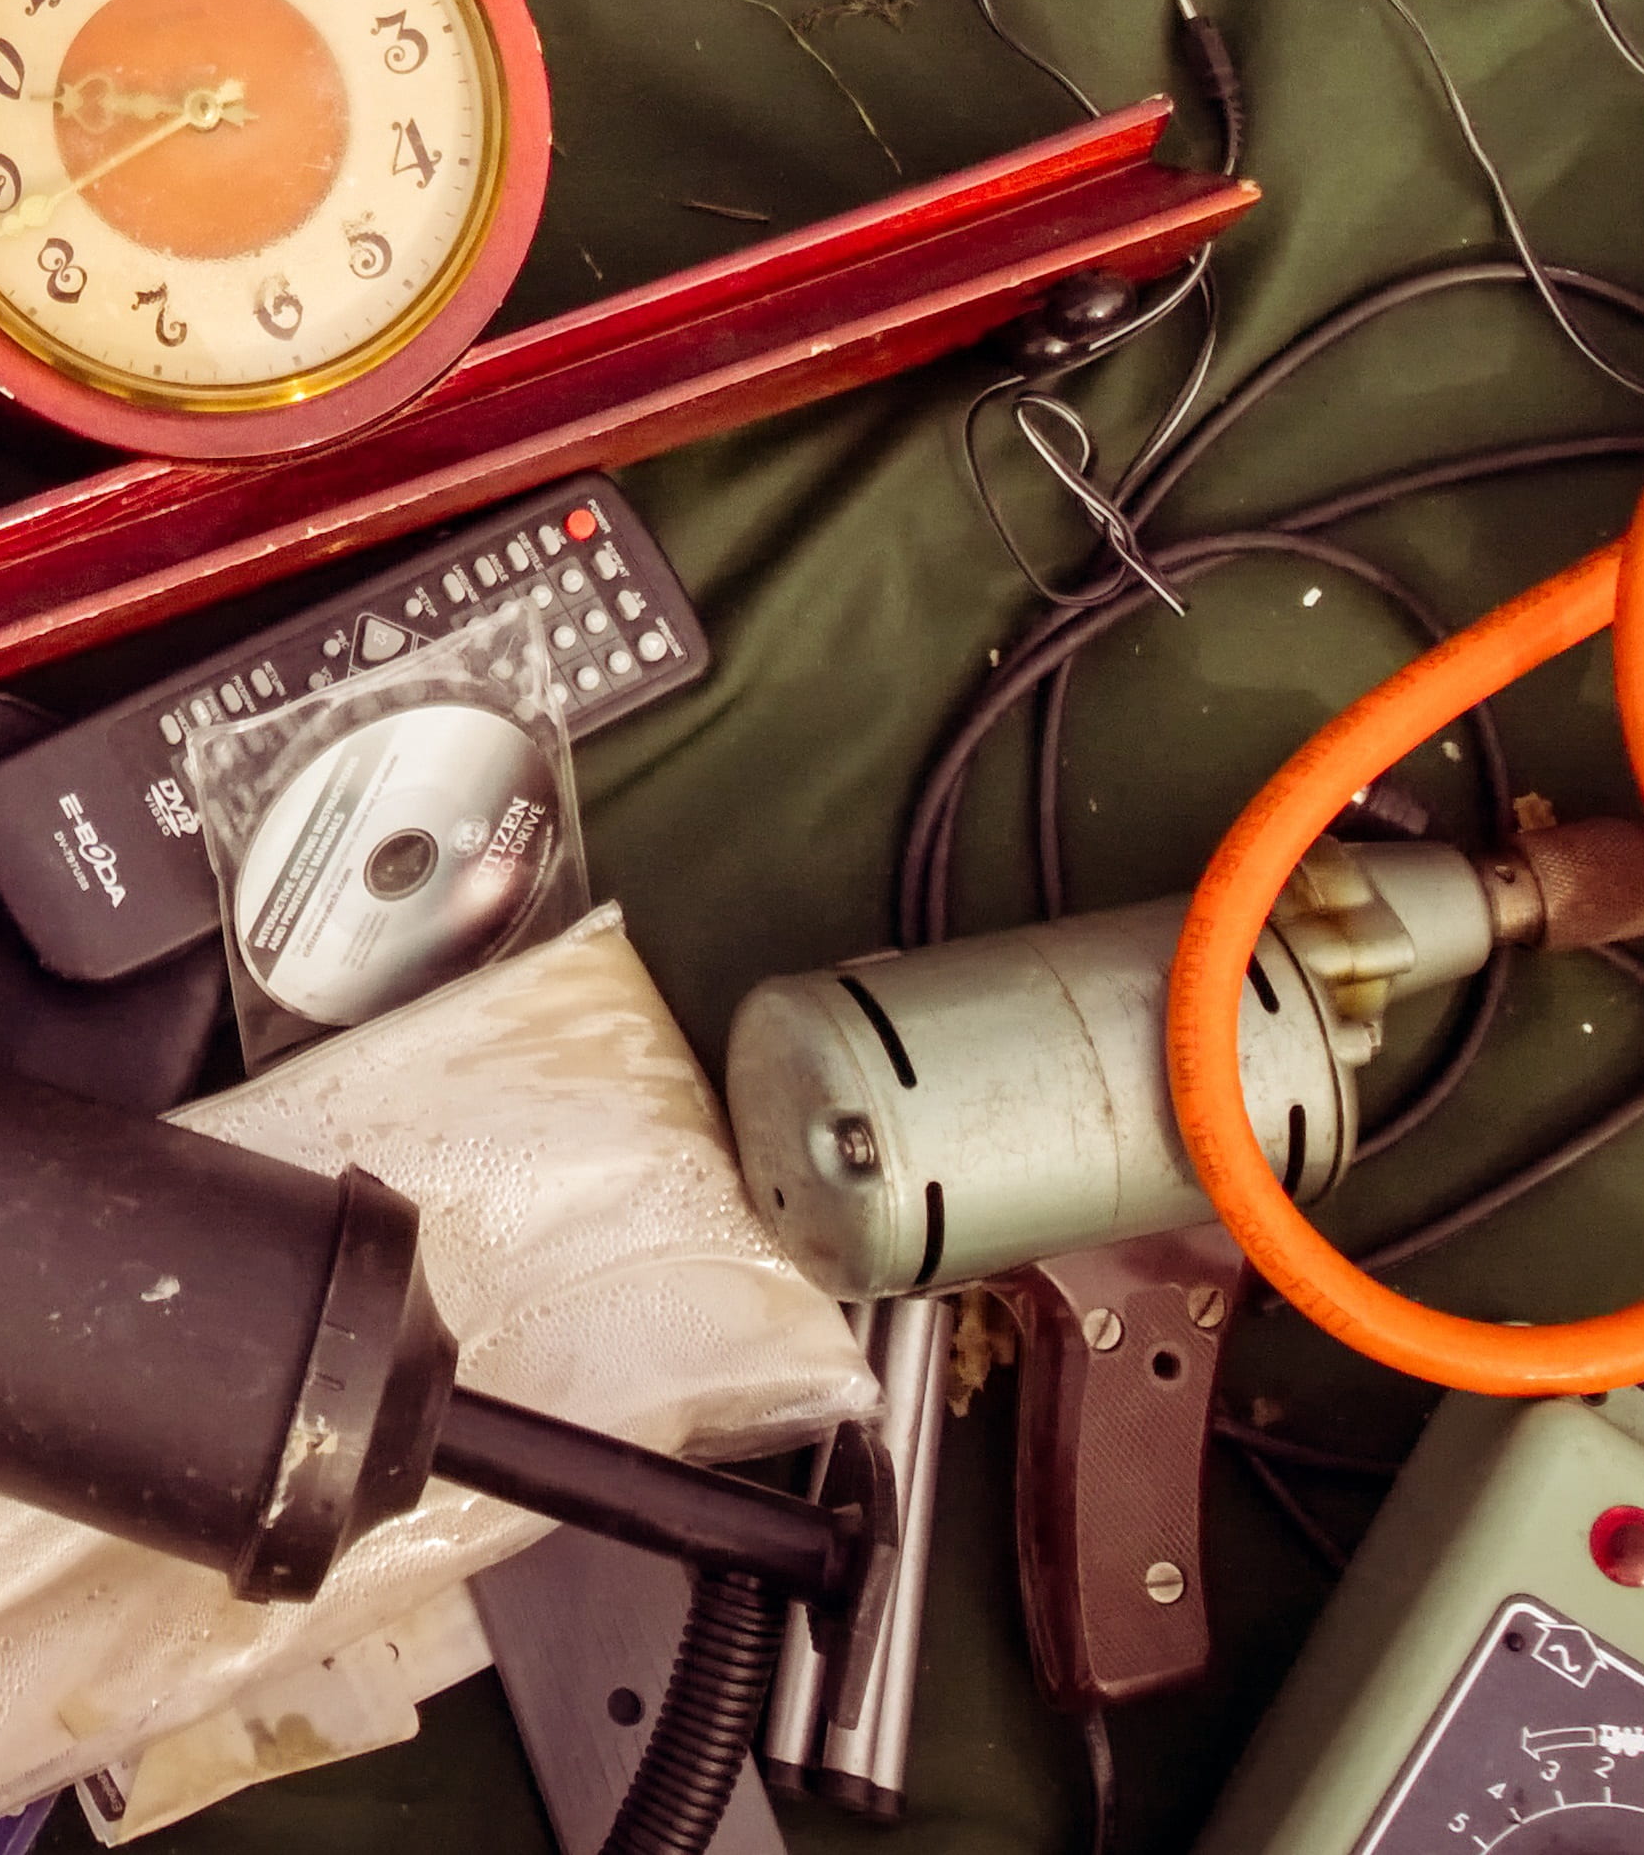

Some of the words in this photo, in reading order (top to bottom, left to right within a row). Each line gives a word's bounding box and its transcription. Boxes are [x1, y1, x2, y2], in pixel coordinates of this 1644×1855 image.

[370, 9, 429, 75] 3
[390, 117, 443, 190] 4
[36, 237, 89, 305] 8
[340, 209, 393, 280] 5
[130, 283, 189, 348] 7
[253, 271, 305, 342] 6
[487, 551, 509, 583] ANGLE
[203, 694, 224, 723] PREV
[261, 659, 287, 697] RETURN
[139, 792, 175, 838] VIDEO
[57, 791, 127, 909] E-BODA
[267, 924, 287, 951] AND
[280, 865, 317, 926] PRINTABLE
[309, 811, 346, 867] MANUALS
[254, 879, 296, 948] INTERACTIVE
[287, 833, 320, 881] SETTING
[1485, 1783, 1507, 1802] 4
[1540, 1760, 1561, 1783] 3
[1593, 1755, 1617, 1778] 2
[1449, 1811, 1470, 1833] 5
